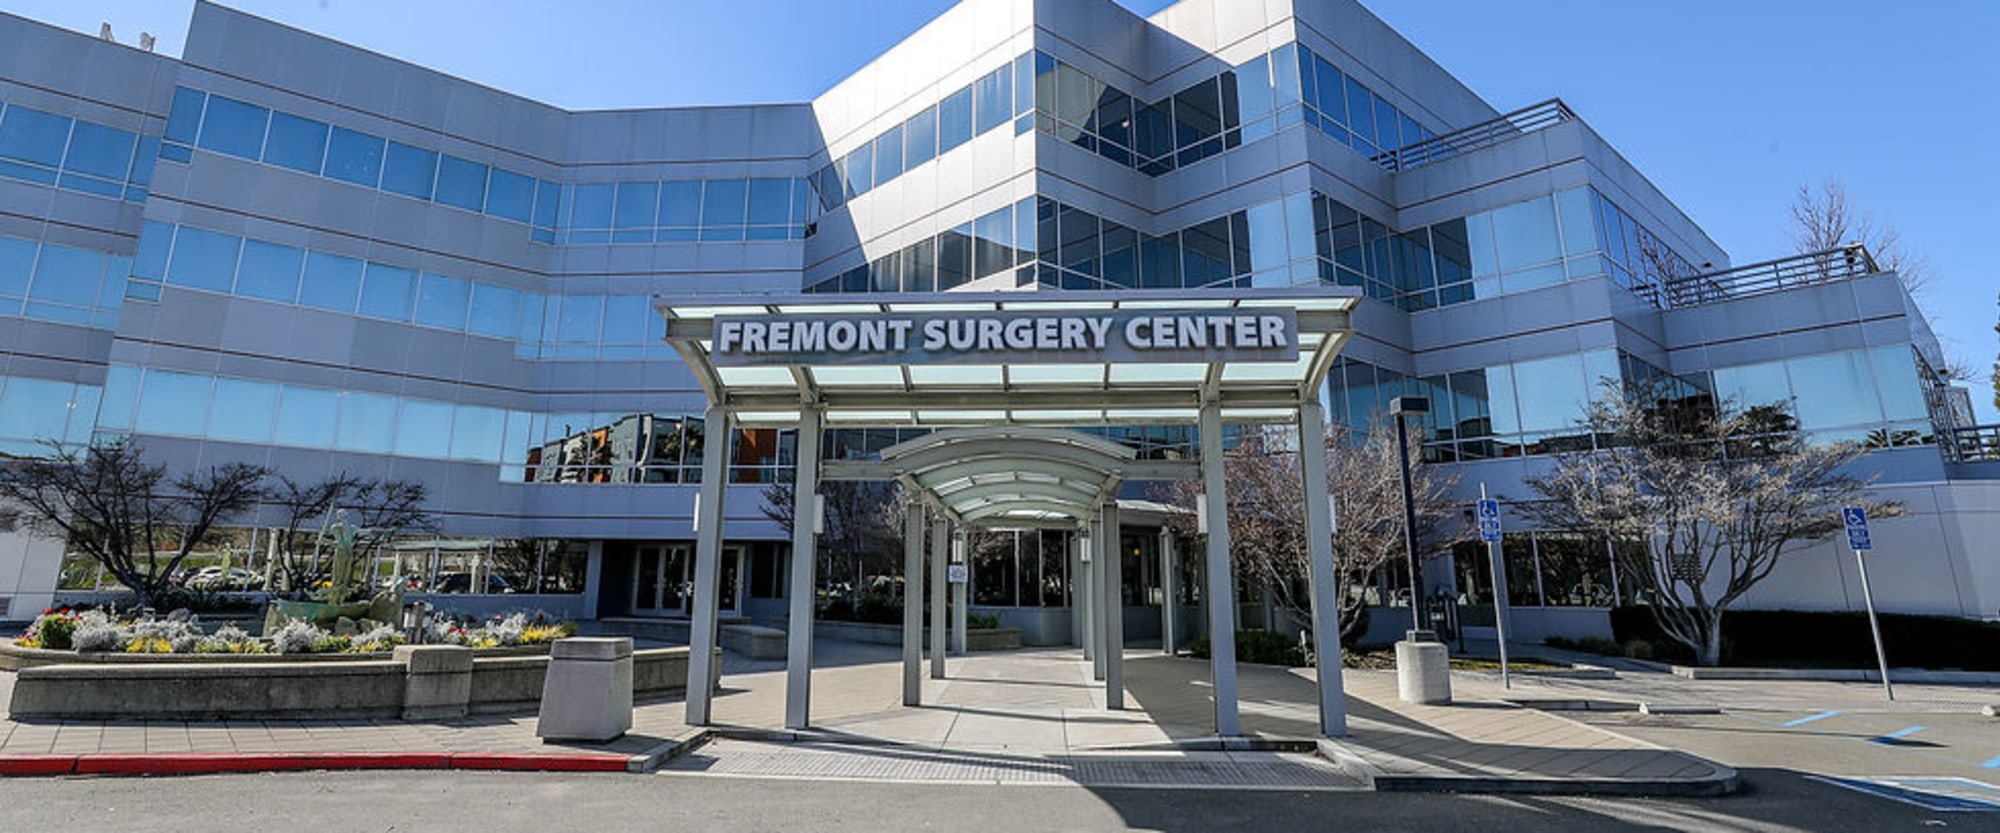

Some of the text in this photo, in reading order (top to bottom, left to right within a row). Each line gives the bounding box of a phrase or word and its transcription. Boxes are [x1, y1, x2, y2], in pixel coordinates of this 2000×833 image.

[720, 315, 1287, 352] FREMONT SURGERY CENTER
